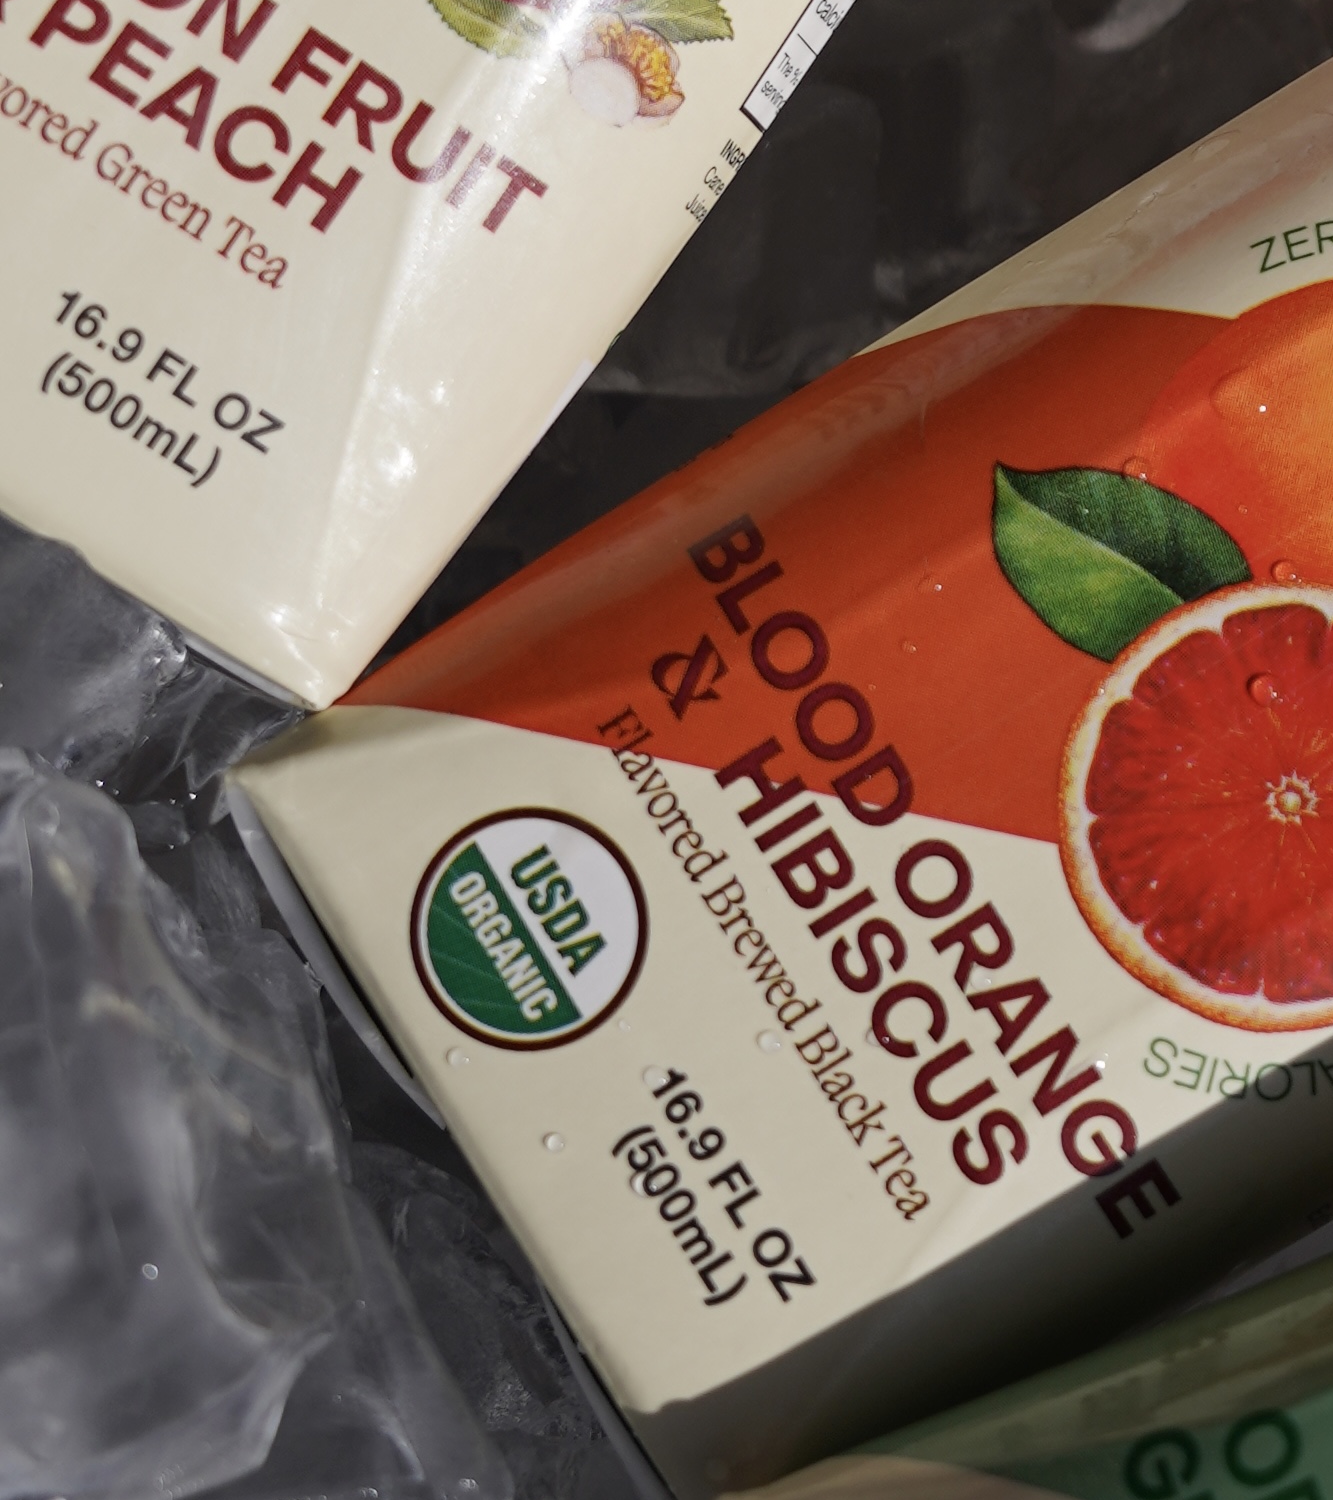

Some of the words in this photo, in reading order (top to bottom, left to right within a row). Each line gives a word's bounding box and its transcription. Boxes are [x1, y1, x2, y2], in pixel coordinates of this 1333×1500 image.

[94, 139, 216, 244] Green
[225, 216, 291, 290] Tea
[272, 27, 549, 235] FRUIT
[41, 350, 222, 488] (500mL)
[54, 292, 146, 362] 16.9
[145, 345, 203, 407] FL
[210, 394, 287, 452] OZ
[448, 870, 559, 1025] ORGANIC
[510, 845, 607, 977] USDA
[598, 705, 724, 884] Flavored
[702, 875, 820, 1034] Brewed
[795, 1025, 888, 1148] Black
[869, 1132, 932, 1224] Tea
[650, 635, 728, 719] &
[714, 735, 1031, 1186] HIBISCUS
[688, 515, 915, 826] BLOOD
[895, 839, 1182, 1241] ORANGE
[610, 1125, 749, 1308] (500mL)
[651, 1067, 728, 1162] 16.9
[707, 1160, 763, 1229] FL
[752, 1213, 816, 1303] OZ
